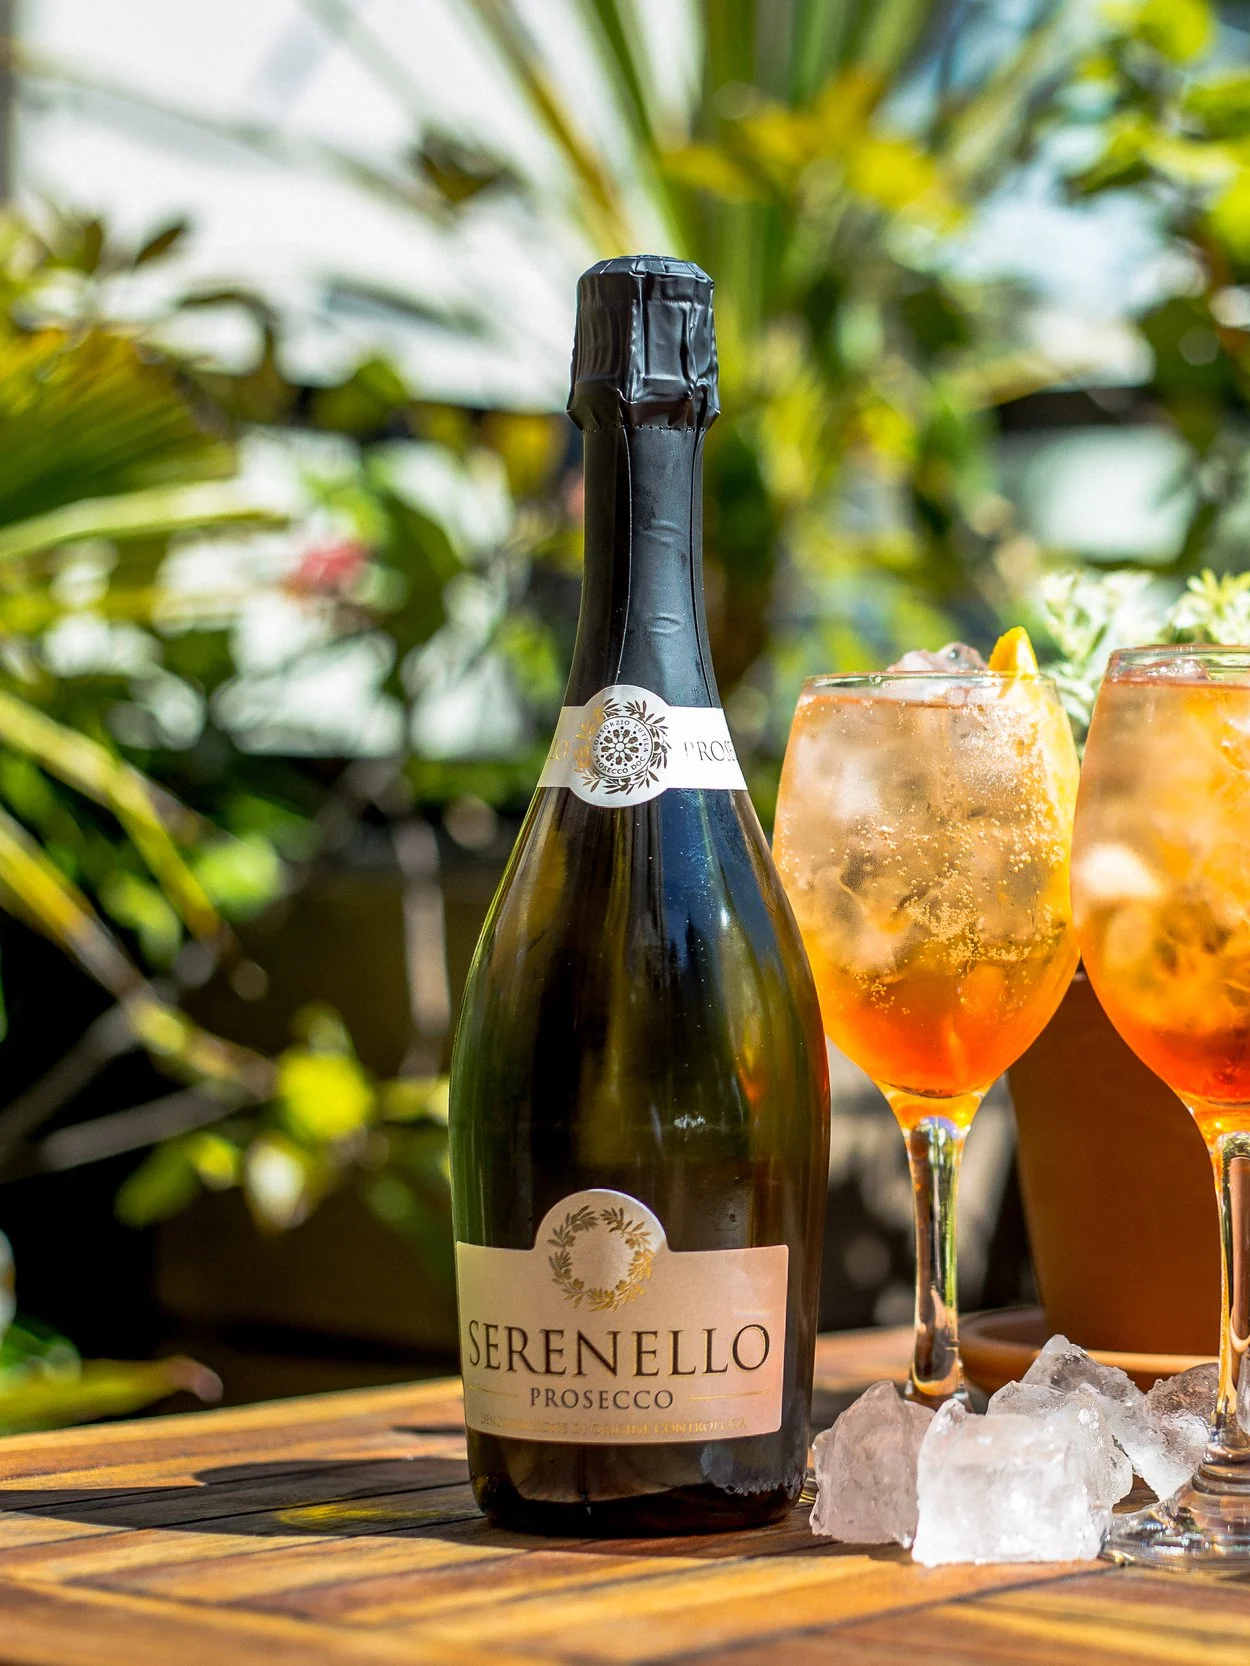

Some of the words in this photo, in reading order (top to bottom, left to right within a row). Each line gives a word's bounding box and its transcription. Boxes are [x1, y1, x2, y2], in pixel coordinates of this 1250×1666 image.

[593, 720, 630, 751] CONSORZIO
[633, 723, 649, 753] TUTELA
[594, 754, 629, 774] PROSECCO
[631, 756, 646, 770] DOC
[468, 1319, 771, 1378] SERENELLO
[529, 1387, 674, 1411] PROSECCO
